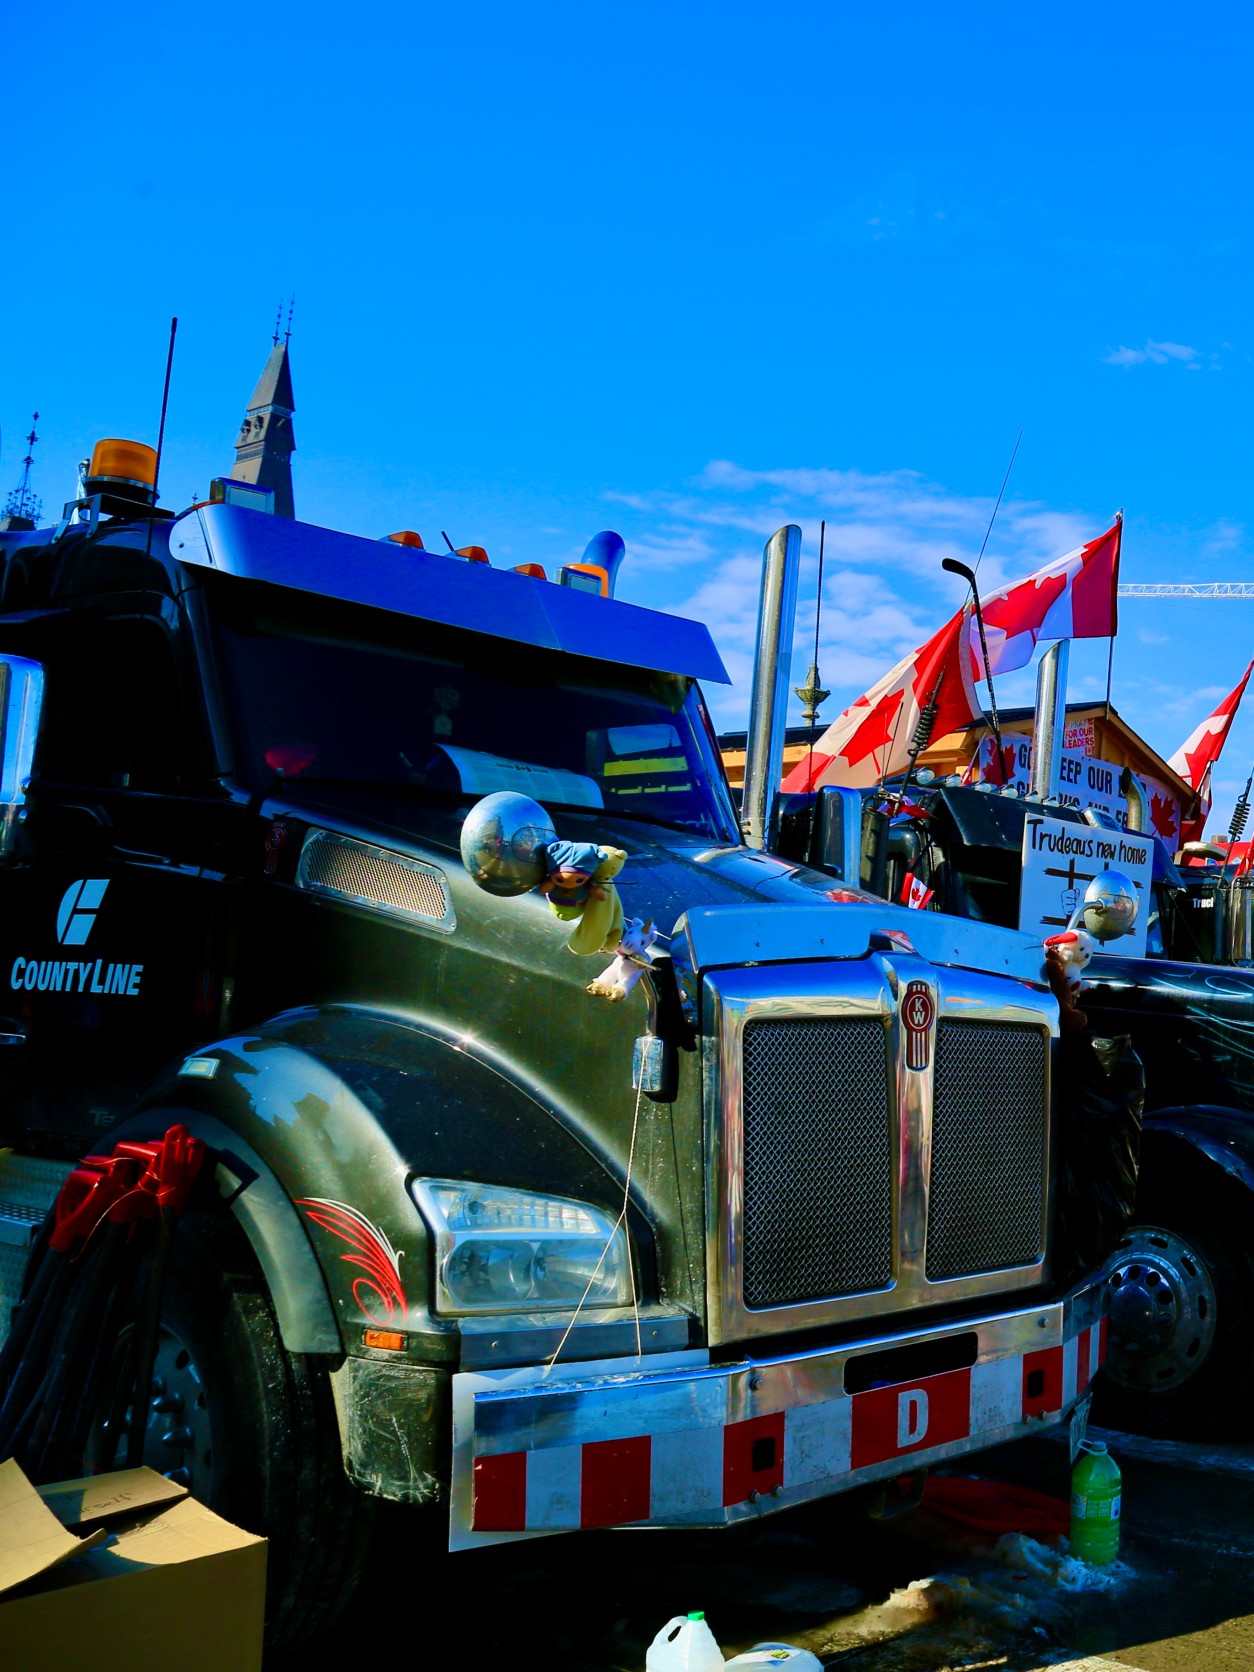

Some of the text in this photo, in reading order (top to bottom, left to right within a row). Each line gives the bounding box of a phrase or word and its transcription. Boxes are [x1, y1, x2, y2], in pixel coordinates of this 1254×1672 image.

[1064, 727, 1093, 739] FOR OUR
[1064, 737, 1094, 749] LEADERS
[1060, 756, 1082, 785] EEP
[1087, 765, 1113, 795] OUR
[1026, 818, 1147, 865] Trudeau's new home
[897, 1388, 929, 1449] D
